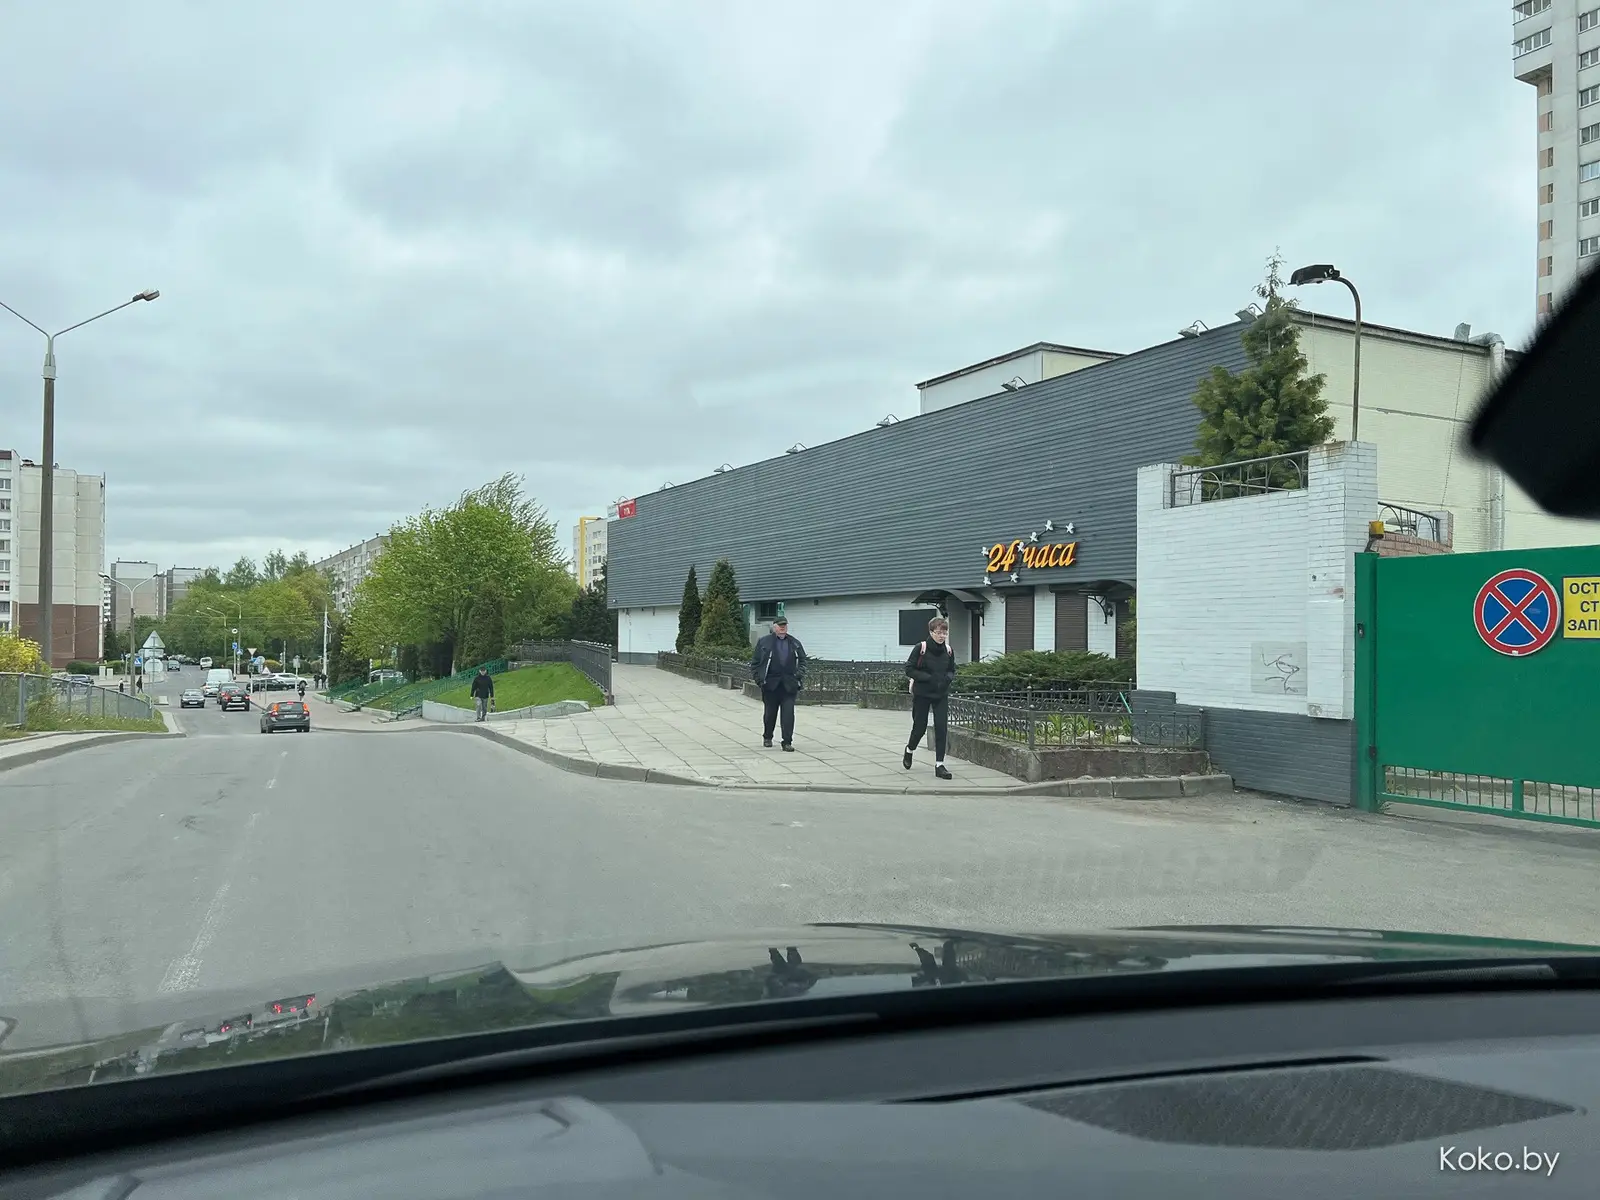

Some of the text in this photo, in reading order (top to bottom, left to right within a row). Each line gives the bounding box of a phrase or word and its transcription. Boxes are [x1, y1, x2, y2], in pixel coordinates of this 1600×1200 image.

[986, 540, 1076, 572] 24 часа
[1569, 582, 1600, 595] ОСТ
[1580, 600, 1600, 613] СТ
[1567, 619, 1600, 631] ЗАП
